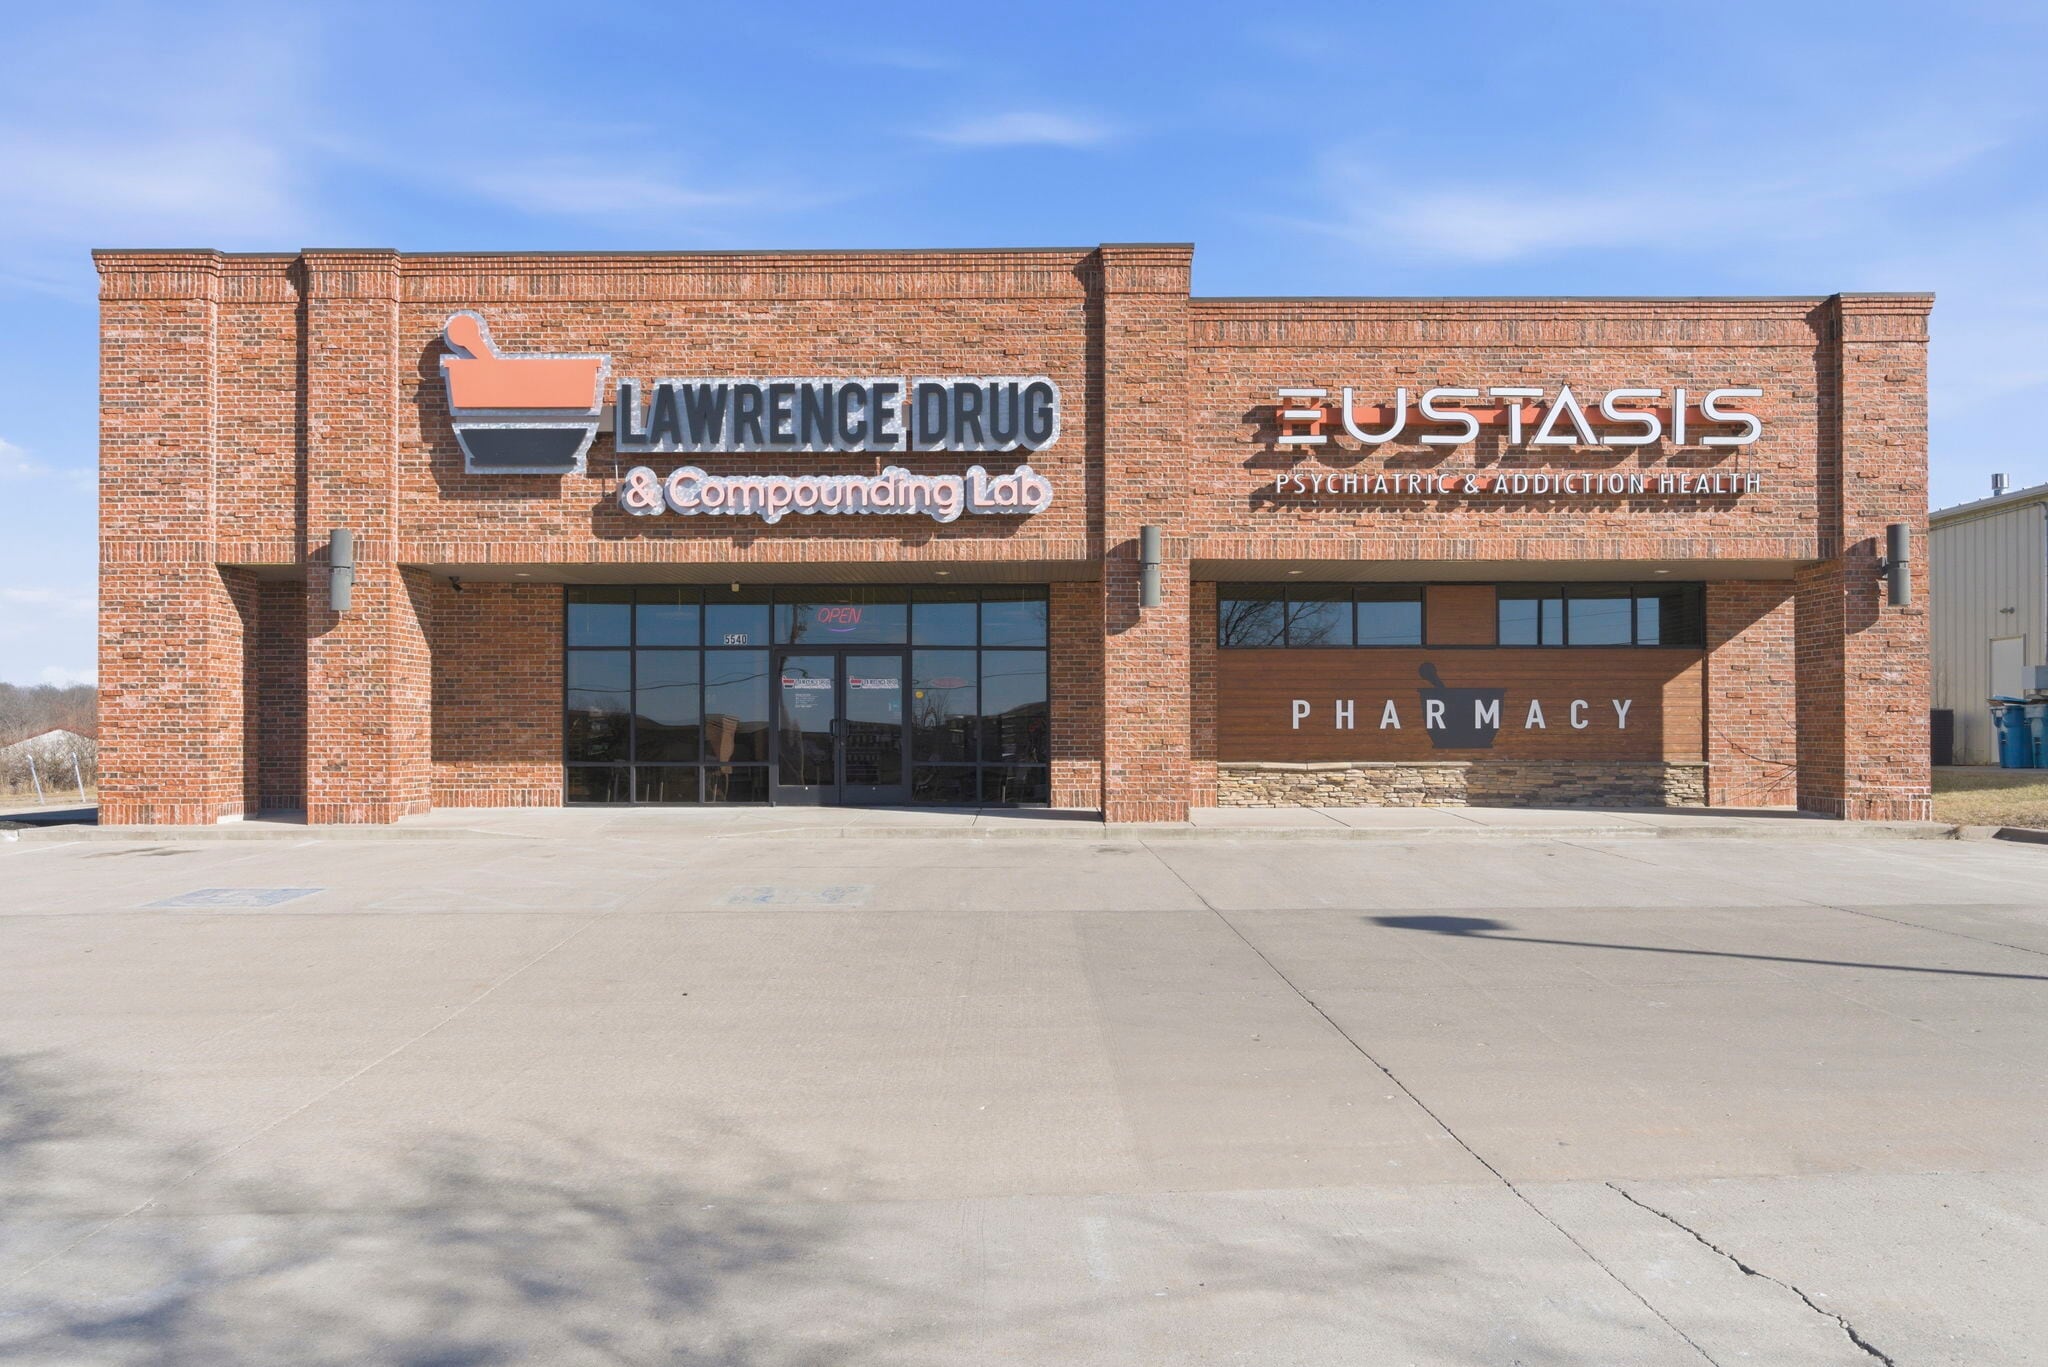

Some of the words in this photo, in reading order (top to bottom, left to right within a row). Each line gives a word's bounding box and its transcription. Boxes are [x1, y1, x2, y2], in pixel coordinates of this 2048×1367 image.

[621, 382, 899, 444] LAWRENCE
[919, 381, 1054, 444] DRUG
[1277, 385, 1764, 446] EUSTASIS
[626, 474, 657, 508] &
[669, 471, 956, 515] Compounding
[972, 472, 1047, 507] Lab
[1275, 473, 1451, 495] PSYCHIATRIC
[1463, 473, 1480, 495] &
[1494, 473, 1646, 495] ADDICTION
[1657, 473, 1762, 495] HEALTH
[817, 607, 862, 624] OPEN
[1292, 699, 1632, 729] PHARMACY
